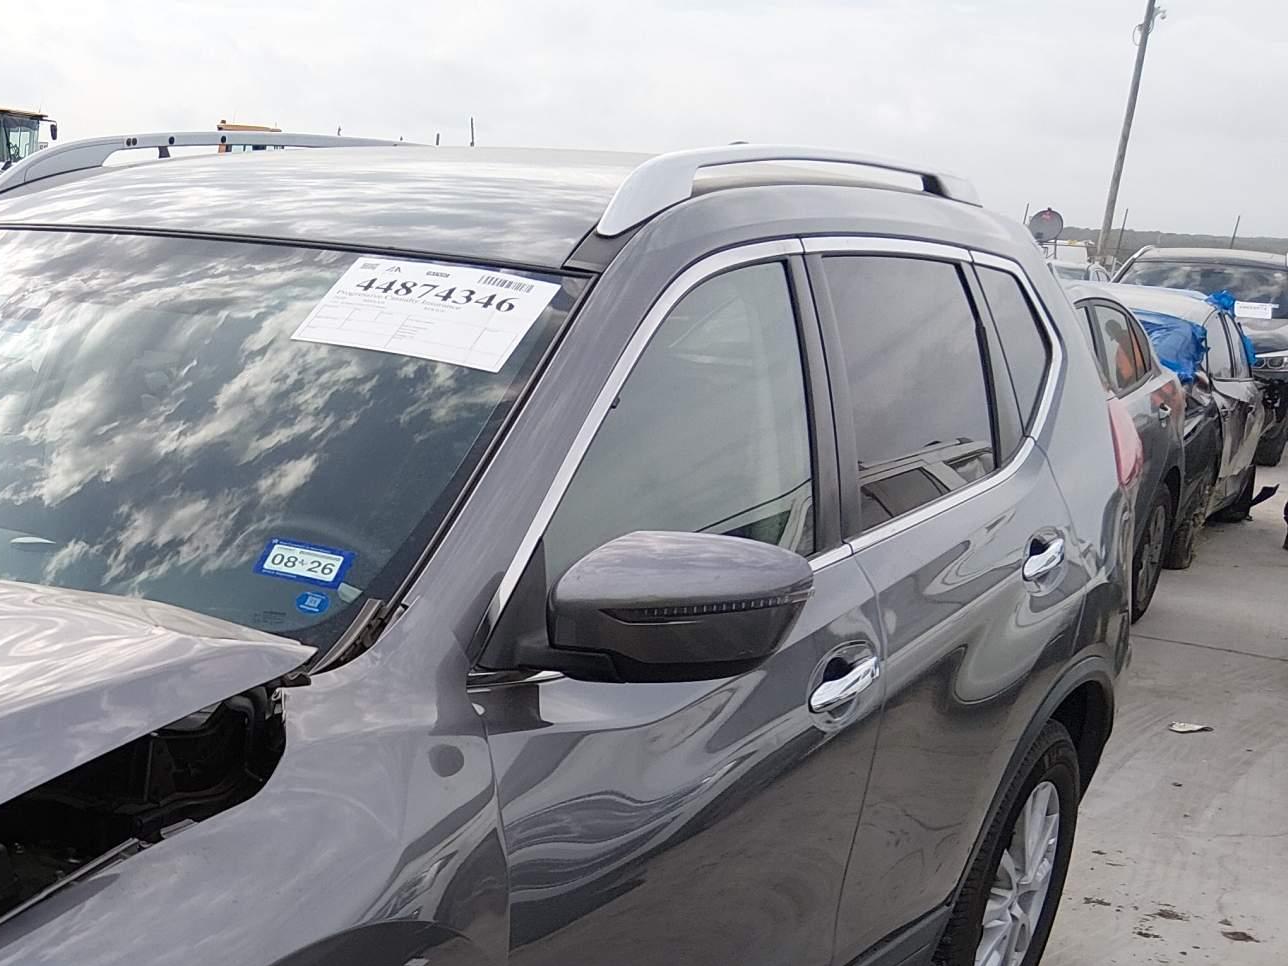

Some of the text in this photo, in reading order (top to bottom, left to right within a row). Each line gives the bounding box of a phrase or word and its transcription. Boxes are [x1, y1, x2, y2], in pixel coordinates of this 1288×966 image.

[355, 277, 521, 313] 44874346
[271, 553, 298, 568] 08
[307, 560, 336, 576] 26
